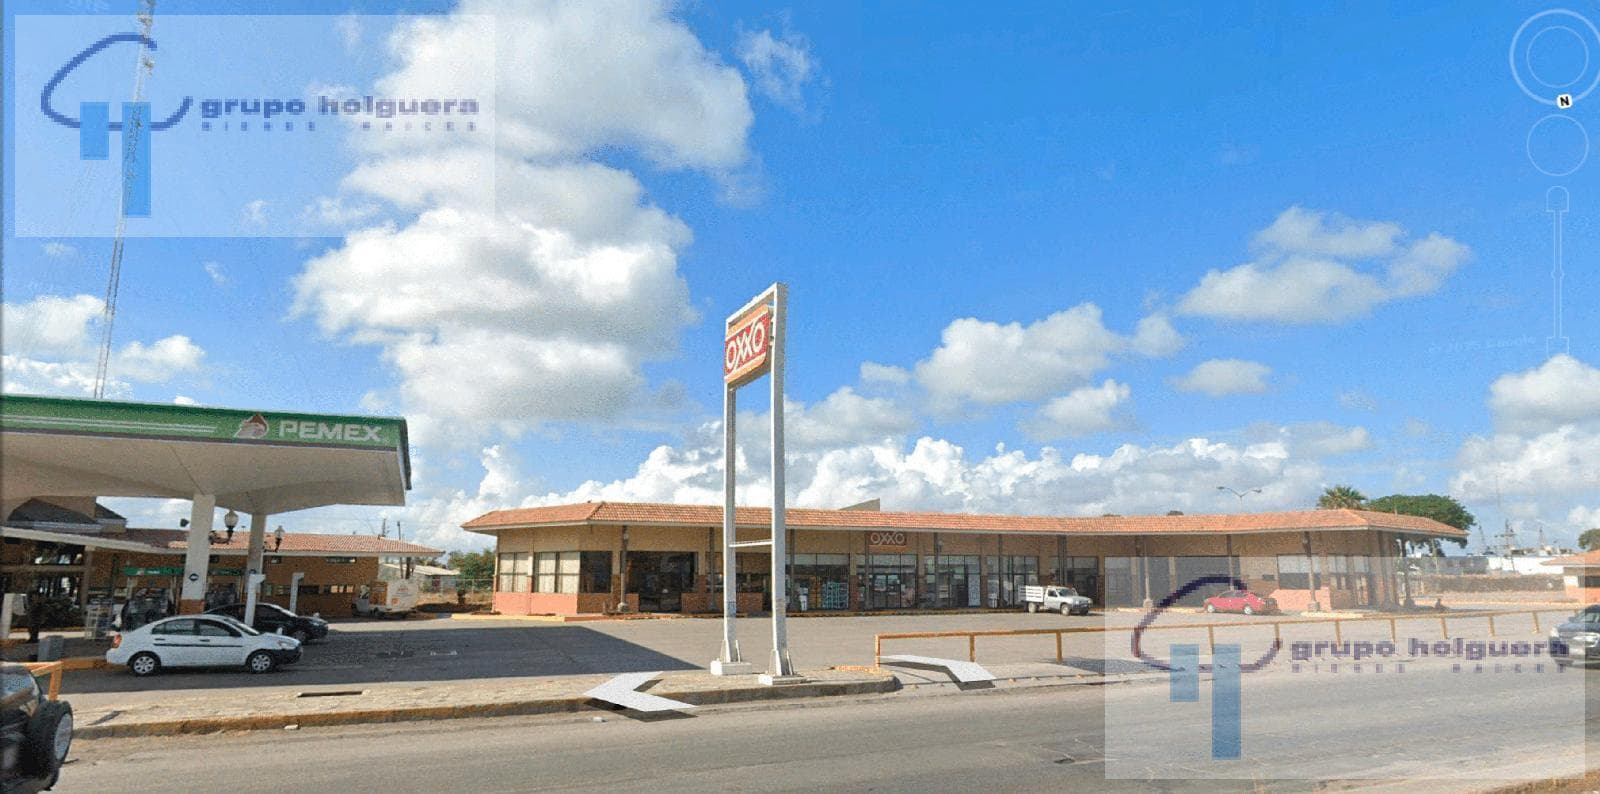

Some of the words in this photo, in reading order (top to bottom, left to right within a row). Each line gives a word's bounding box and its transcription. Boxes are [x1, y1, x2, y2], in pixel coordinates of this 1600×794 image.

[726, 318, 765, 370] OXXO
[279, 420, 382, 441] PEMEX
[870, 531, 905, 545] OXXO
